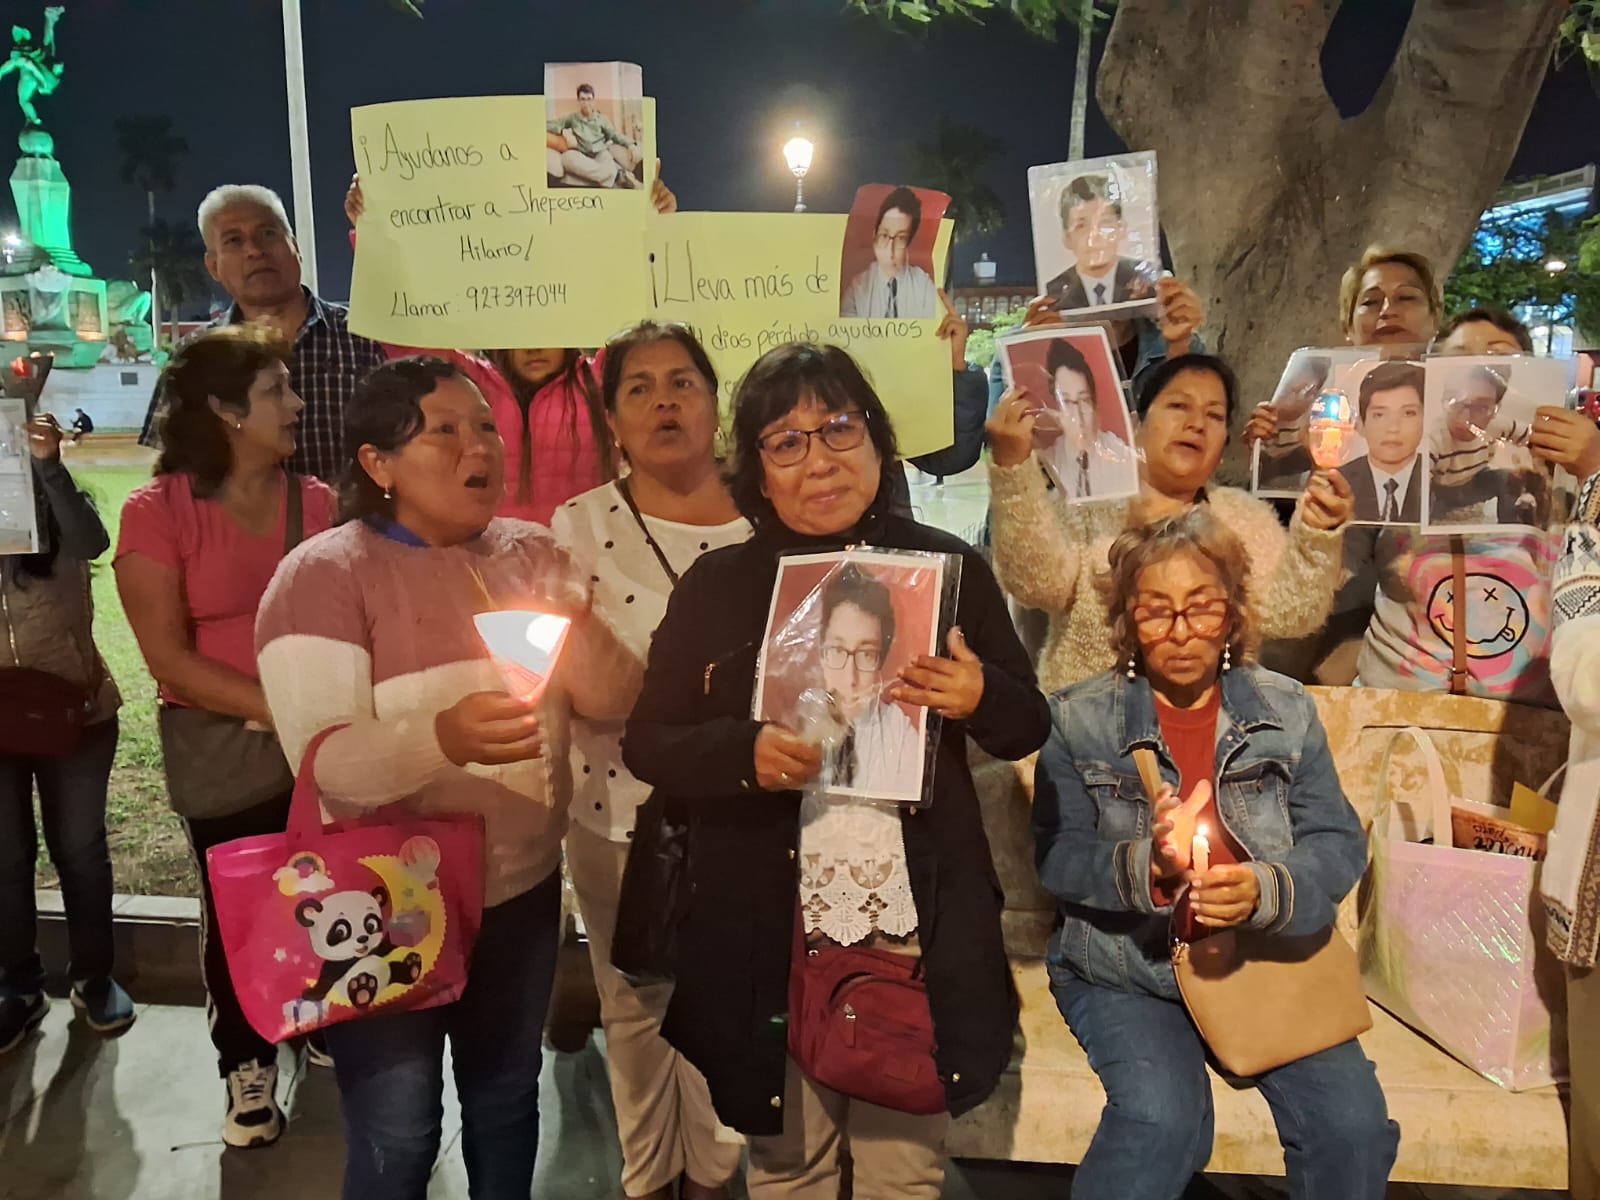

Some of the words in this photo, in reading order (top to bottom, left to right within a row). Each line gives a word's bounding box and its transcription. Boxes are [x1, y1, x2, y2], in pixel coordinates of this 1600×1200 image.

[499, 143, 519, 161] a
[390, 195, 476, 228] encontrar
[484, 201, 501, 217] a
[459, 233, 534, 263] Hilario!
[744, 265, 793, 300] más
[805, 255, 830, 294] de
[466, 282, 567, 312] 927397044
[828, 318, 923, 349] ayudanos
